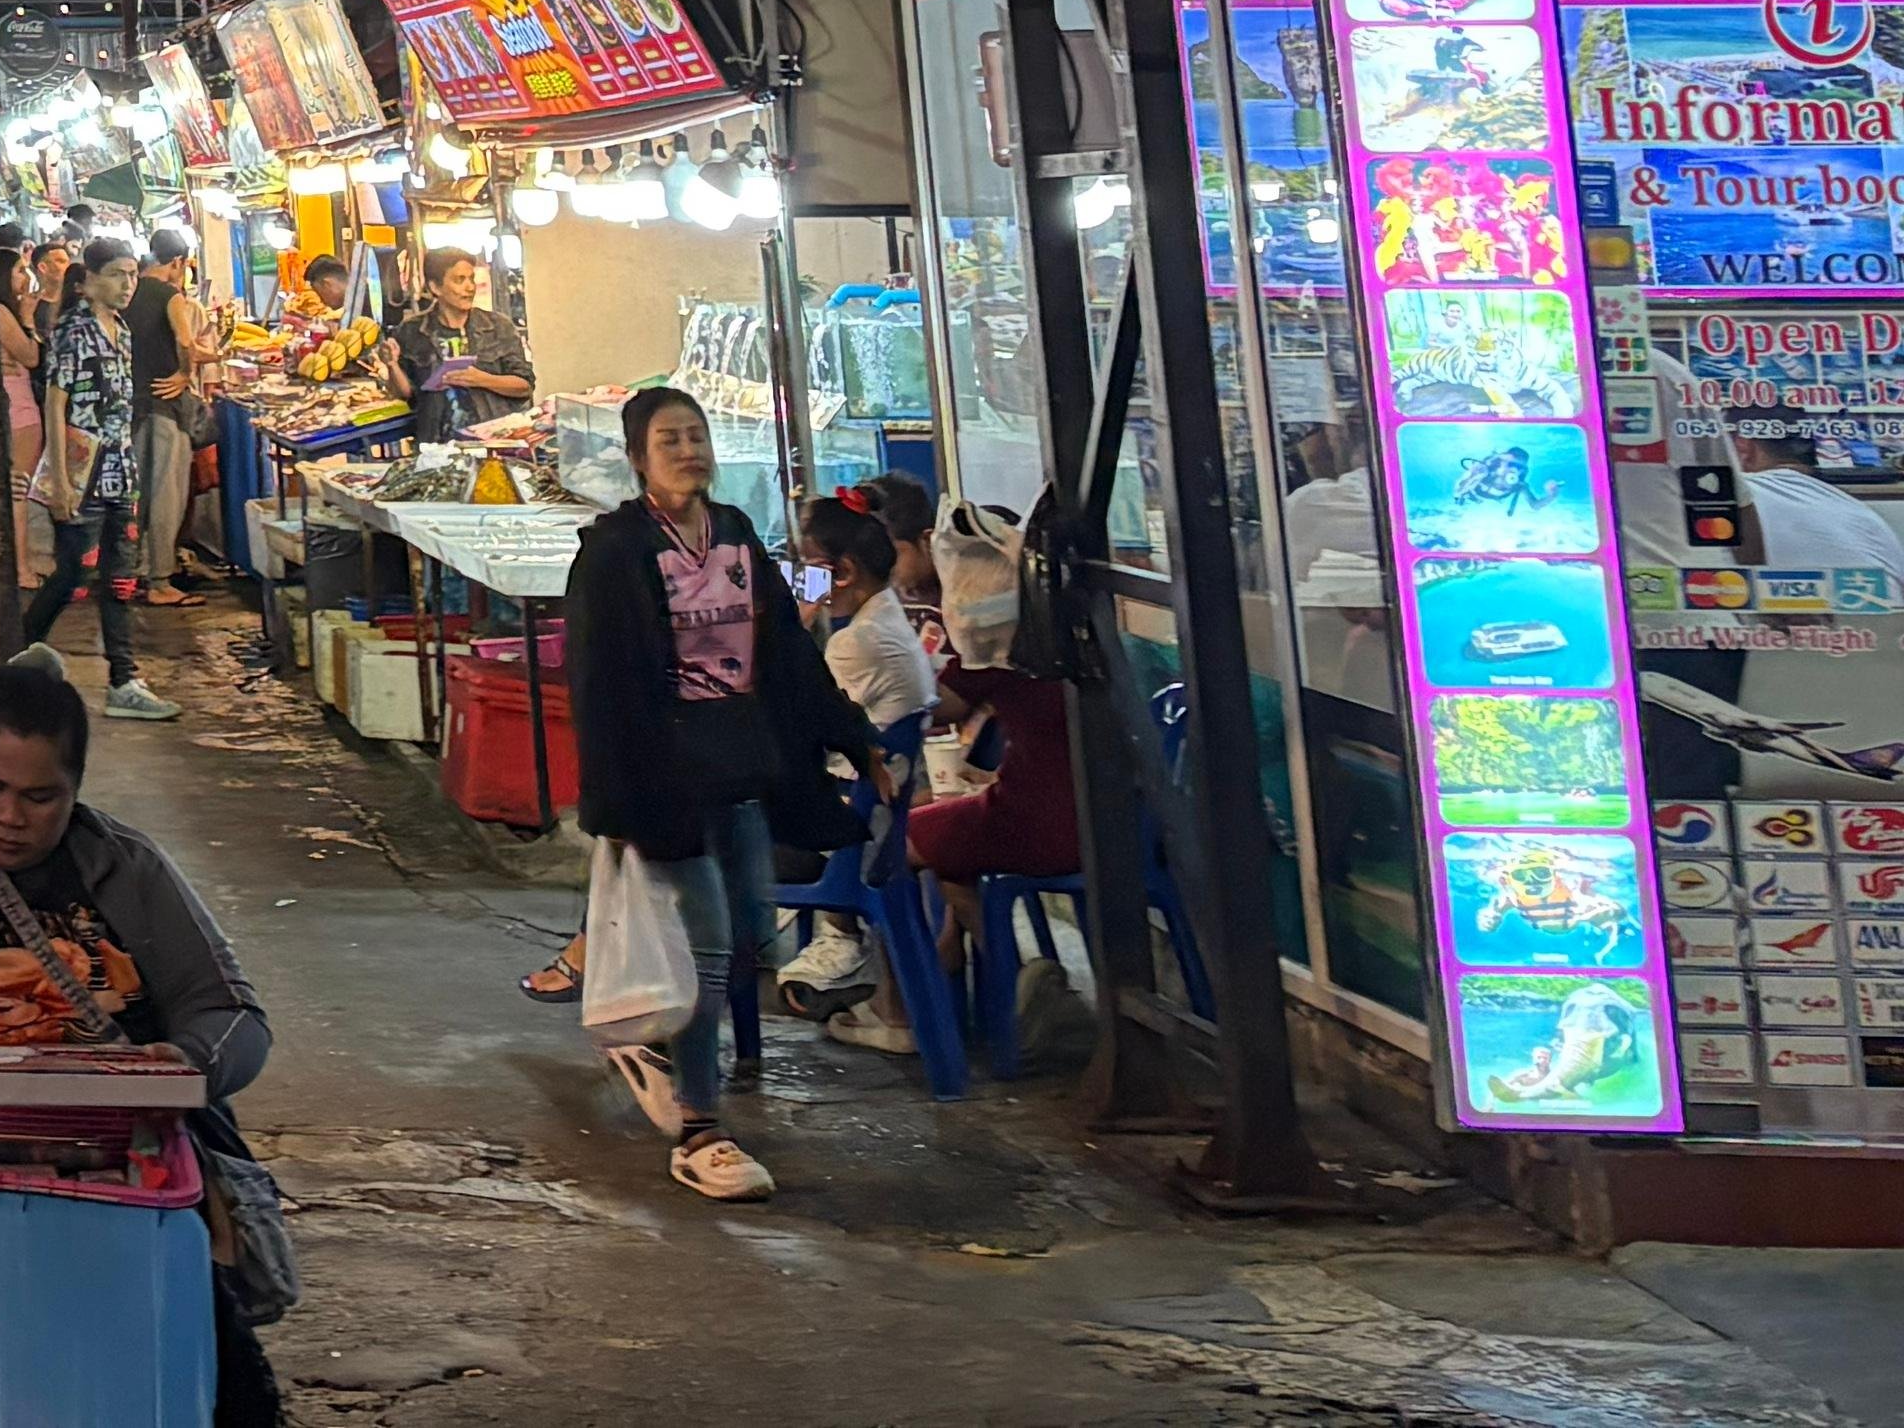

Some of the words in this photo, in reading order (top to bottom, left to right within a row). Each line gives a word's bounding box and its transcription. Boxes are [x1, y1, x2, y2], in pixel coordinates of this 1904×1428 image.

[1630, 166, 1672, 207] &
[1681, 165, 1807, 207] Tour
[1699, 253, 1904, 285] WELCO
[1698, 312, 1845, 367] Open
[1786, 383, 1840, 407] am
[1711, 624, 1788, 650] Wide
